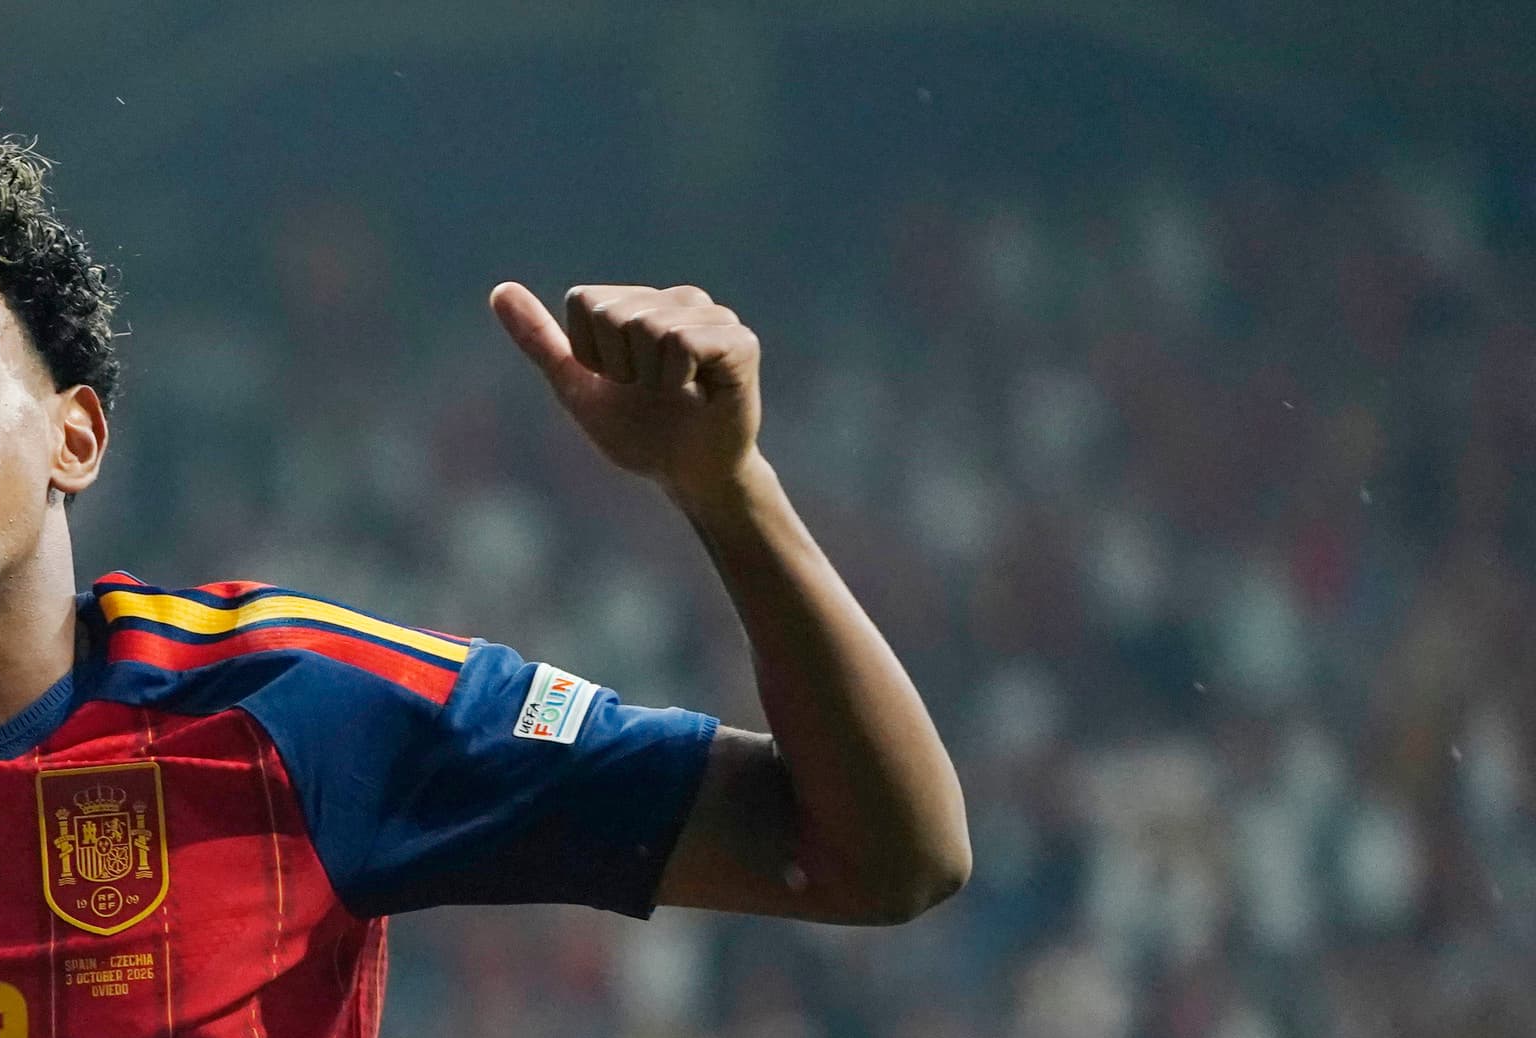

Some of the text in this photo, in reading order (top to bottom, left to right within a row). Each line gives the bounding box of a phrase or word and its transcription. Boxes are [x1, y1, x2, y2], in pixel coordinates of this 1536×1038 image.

[519, 702, 540, 734] UEFA
[65, 957, 97, 971] SPAIN
[110, 953, 154, 967] CZECHIA
[66, 968, 154, 985] 3 OCTOBER 2026
[91, 983, 129, 997] OVIEDO
